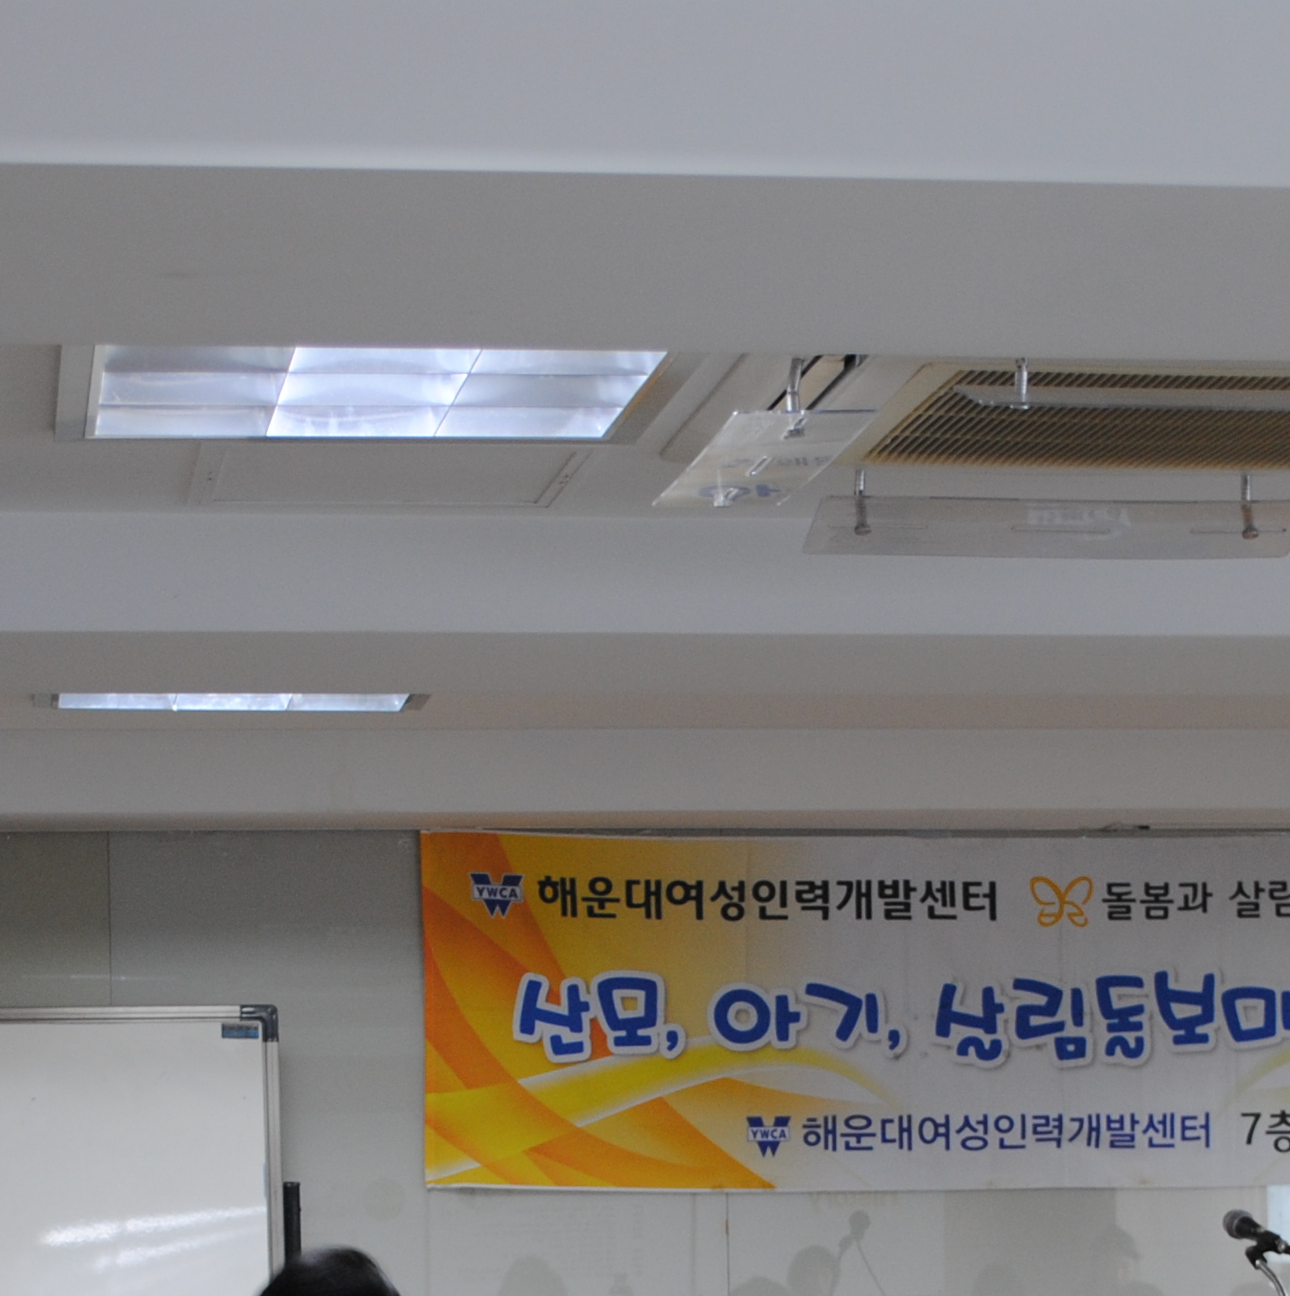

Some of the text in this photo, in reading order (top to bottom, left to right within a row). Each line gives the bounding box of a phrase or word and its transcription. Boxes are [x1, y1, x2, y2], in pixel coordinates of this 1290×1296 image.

[476, 885, 520, 899] YWCA
[537, 874, 999, 922] 해운대여성인력개발센터
[1101, 880, 1214, 921] 돌봄과
[518, 975, 681, 1057] 산모,
[712, 981, 902, 1052] 아기,
[749, 1127, 788, 1140] YWCA
[802, 1112, 1212, 1153] 해운대여성인력개발센터
